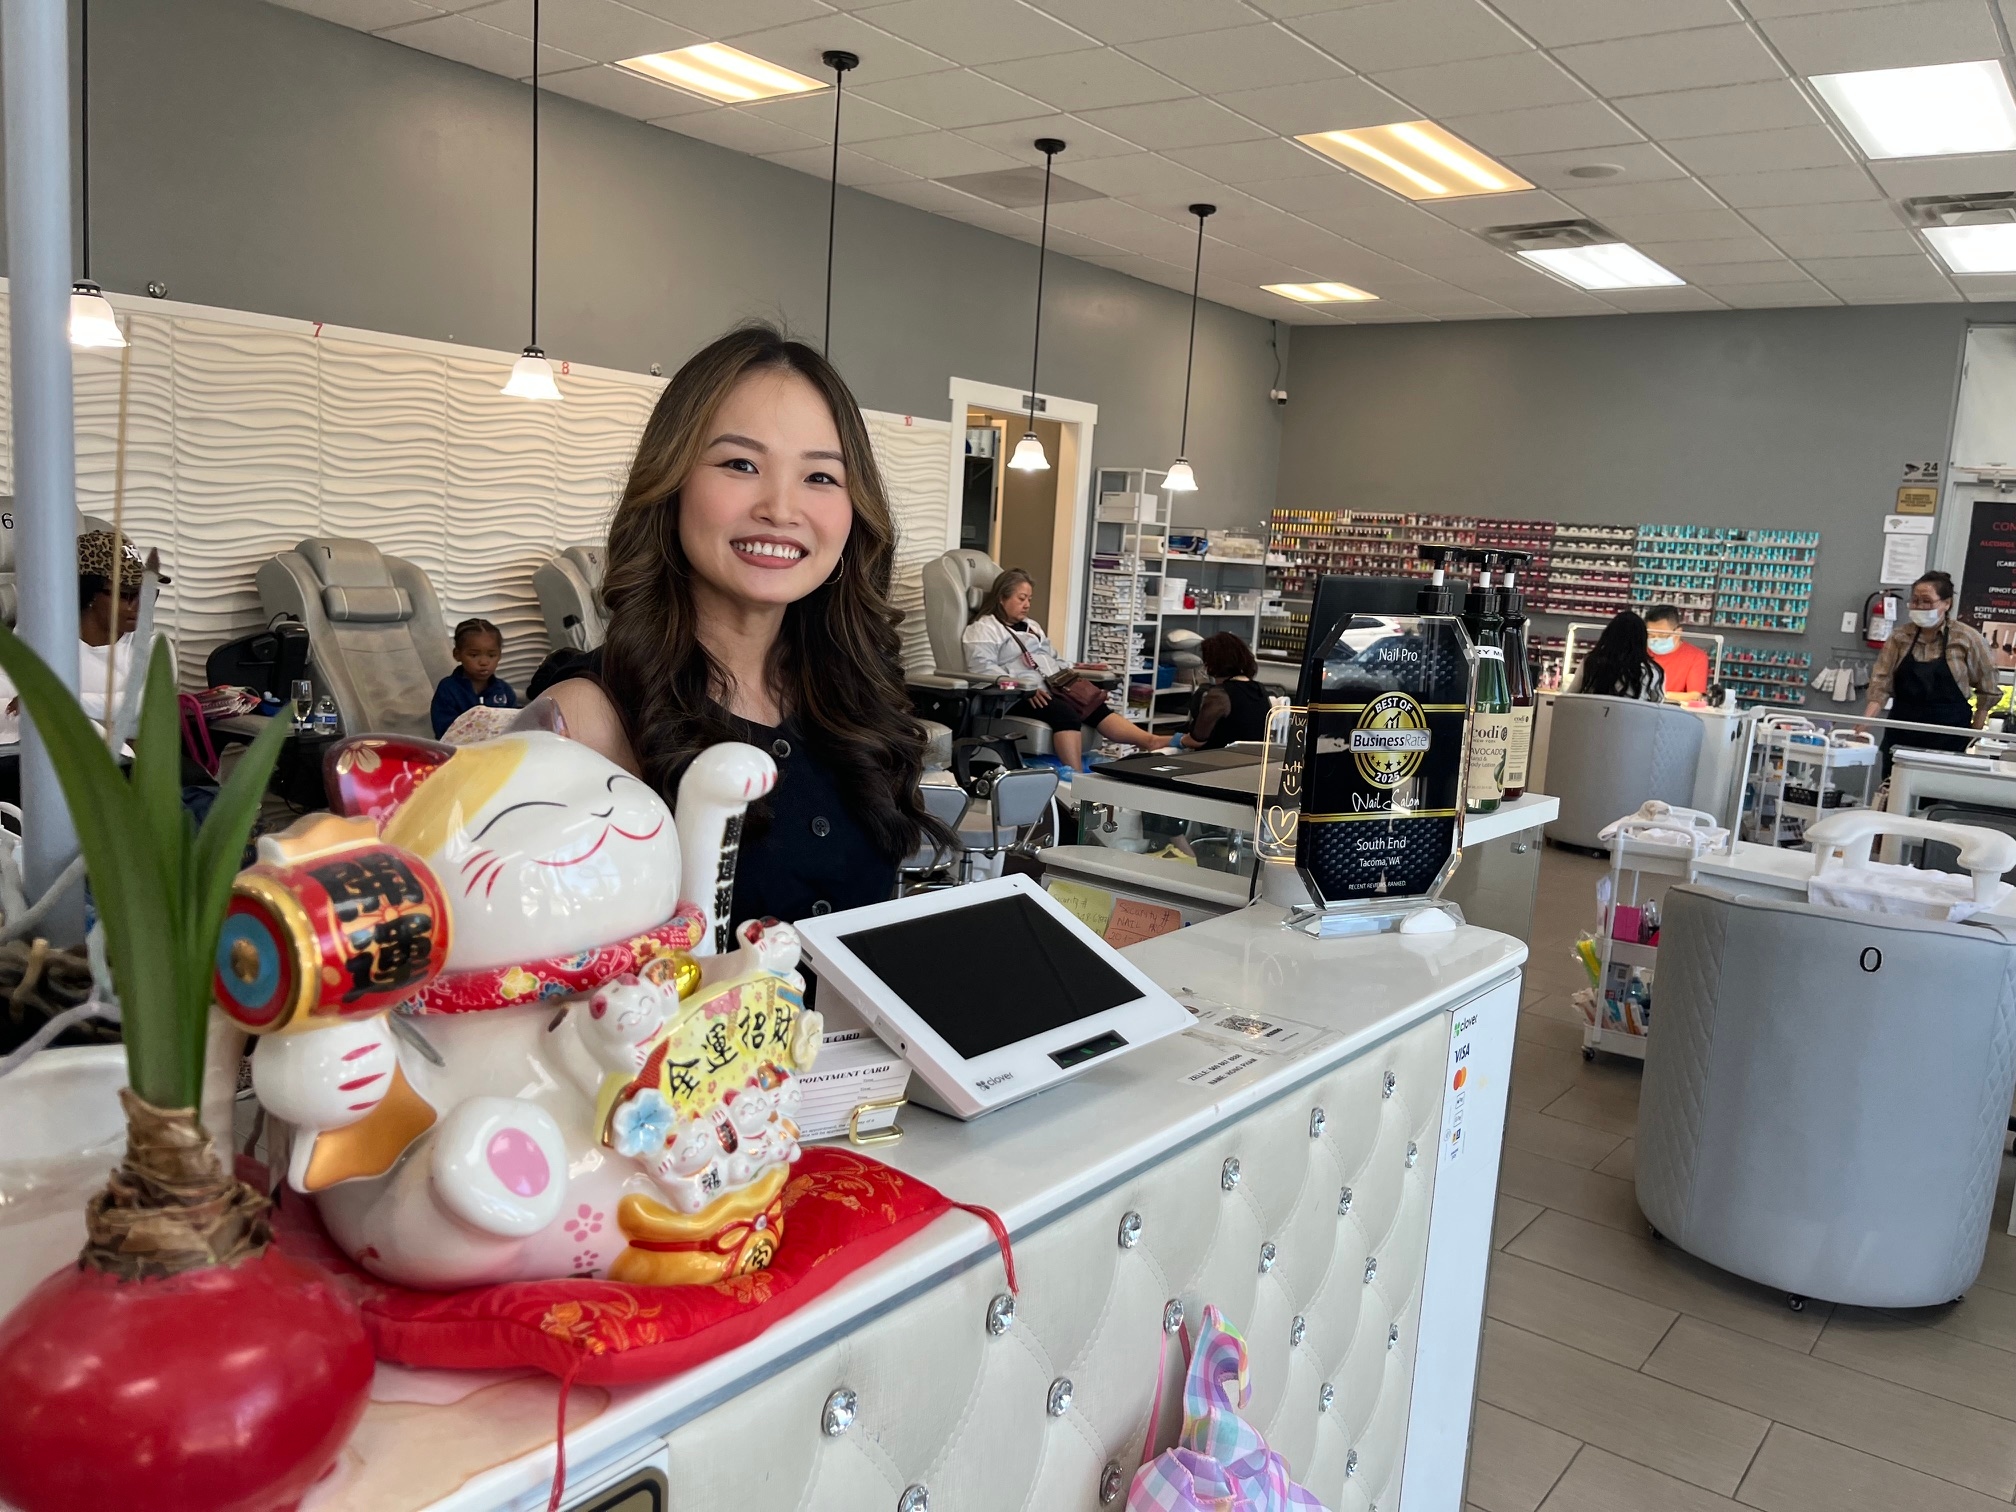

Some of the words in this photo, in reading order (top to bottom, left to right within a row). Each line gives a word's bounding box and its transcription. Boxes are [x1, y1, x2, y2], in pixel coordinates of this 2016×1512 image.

[312, 322, 323, 337] 7
[561, 361, 570, 374] 8
[1922, 462, 1938, 472] 24
[1, 512, 14, 529] 6
[1379, 648, 1399, 661] Nail
[1401, 648, 1418, 662] Pro
[1374, 698, 1399, 713] BEST
[1399, 699, 1413, 712] OF
[1602, 706, 1610, 718] 7
[1472, 725, 1499, 739] codi
[1353, 734, 1428, 748] BusinessRate
[1374, 771, 1400, 784] 2025
[1352, 792, 1381, 812] Nail
[1356, 838, 1386, 851] South
[1388, 836, 1407, 849] End
[1360, 857, 1388, 868] Tacoma,
[1389, 856, 1401, 865] WA
[1116, 916, 1141, 928] NAIL
[1460, 1014, 1478, 1032] clover
[834, 1032, 860, 1042] CARD
[1454, 1042, 1470, 1063] VISA
[862, 1066, 890, 1075] CARD
[986, 1072, 1014, 1086] clover
